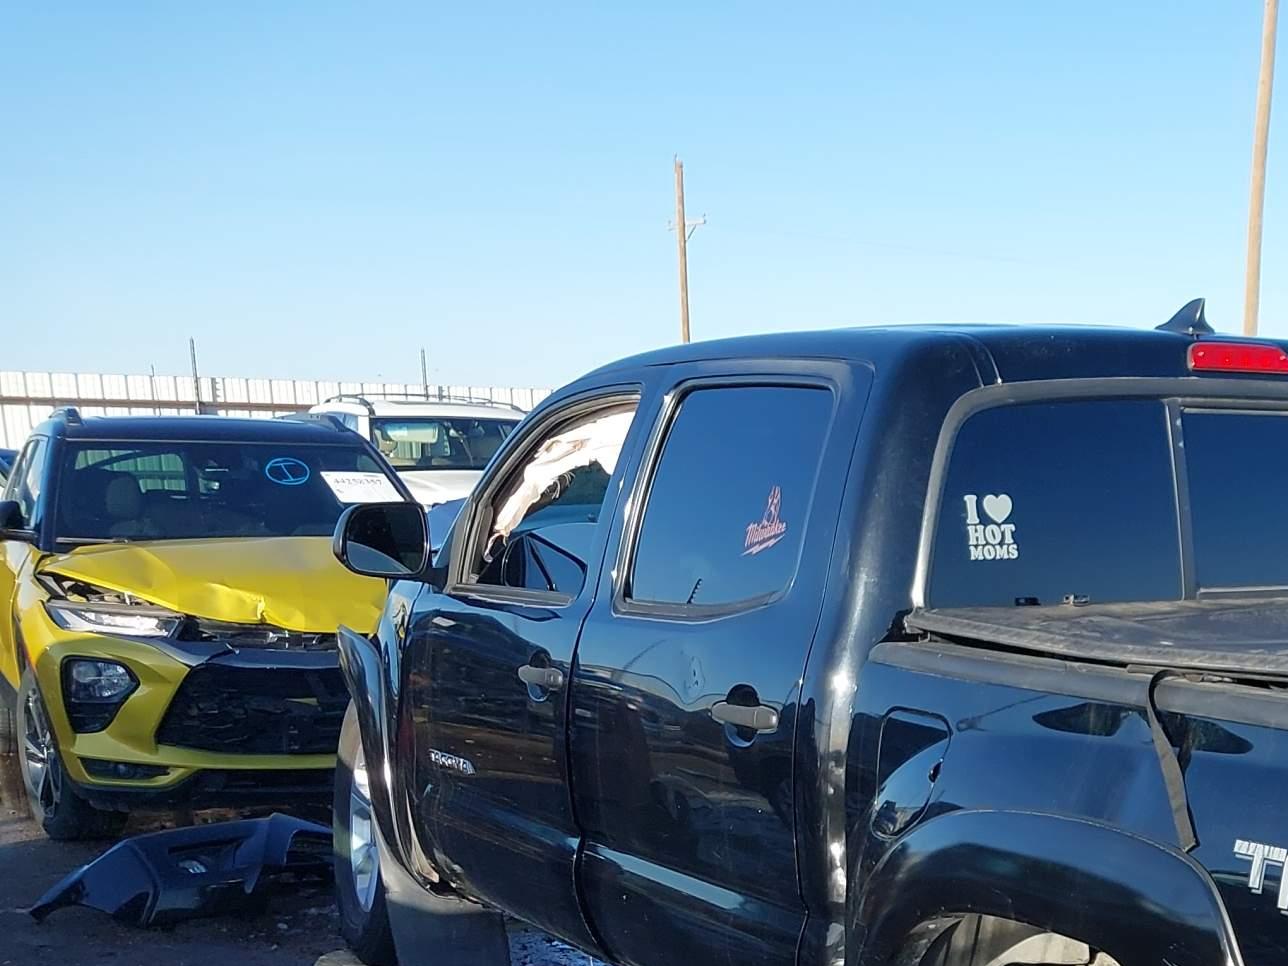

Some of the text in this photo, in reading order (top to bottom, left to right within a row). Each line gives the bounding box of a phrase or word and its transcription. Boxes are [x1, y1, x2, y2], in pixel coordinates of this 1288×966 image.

[963, 494, 980, 524] I
[967, 524, 1016, 545] HOT
[969, 544, 1019, 561] MOMS
